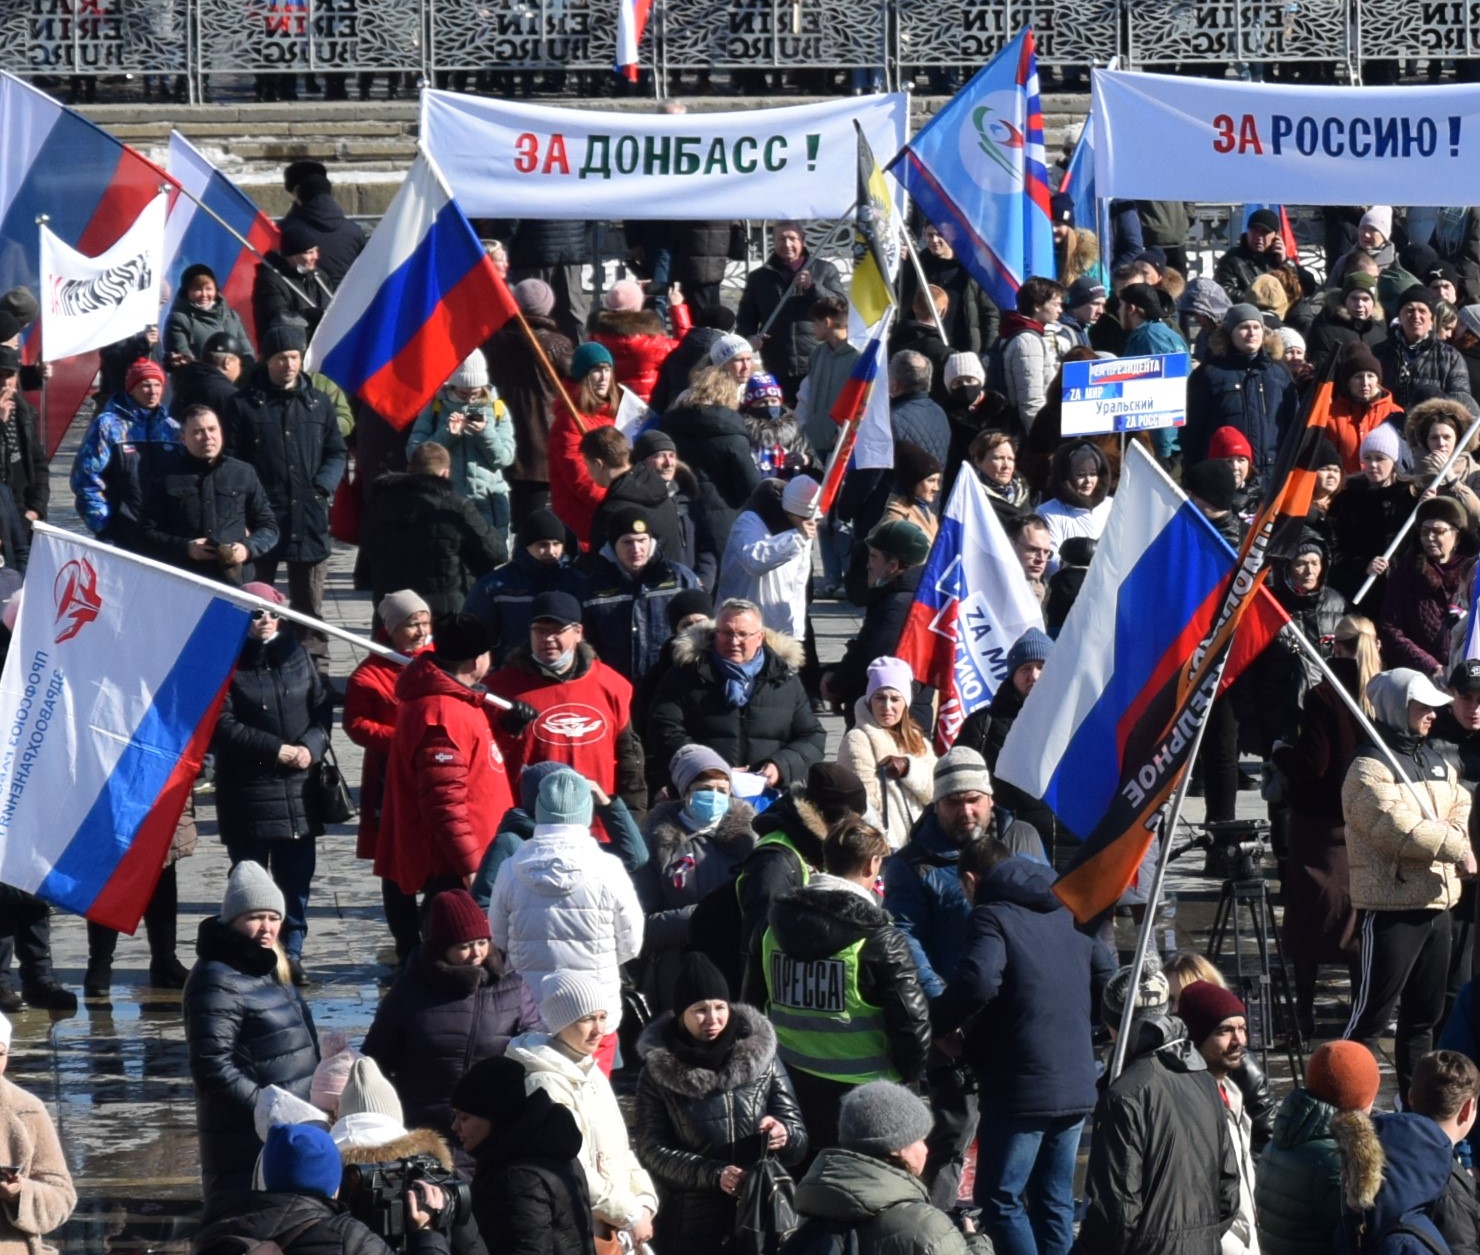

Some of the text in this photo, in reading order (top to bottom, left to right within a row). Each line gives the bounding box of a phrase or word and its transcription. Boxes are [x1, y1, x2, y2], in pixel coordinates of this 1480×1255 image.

[1212, 114, 1262, 154] ЗА
[514, 132, 570, 175] ЗА
[1070, 387, 1104, 401] ZA МИР
[1096, 398, 1154, 415] Уральский
[1125, 415, 1136, 429] ZA
[773, 954, 842, 1010] ПРЕССА
